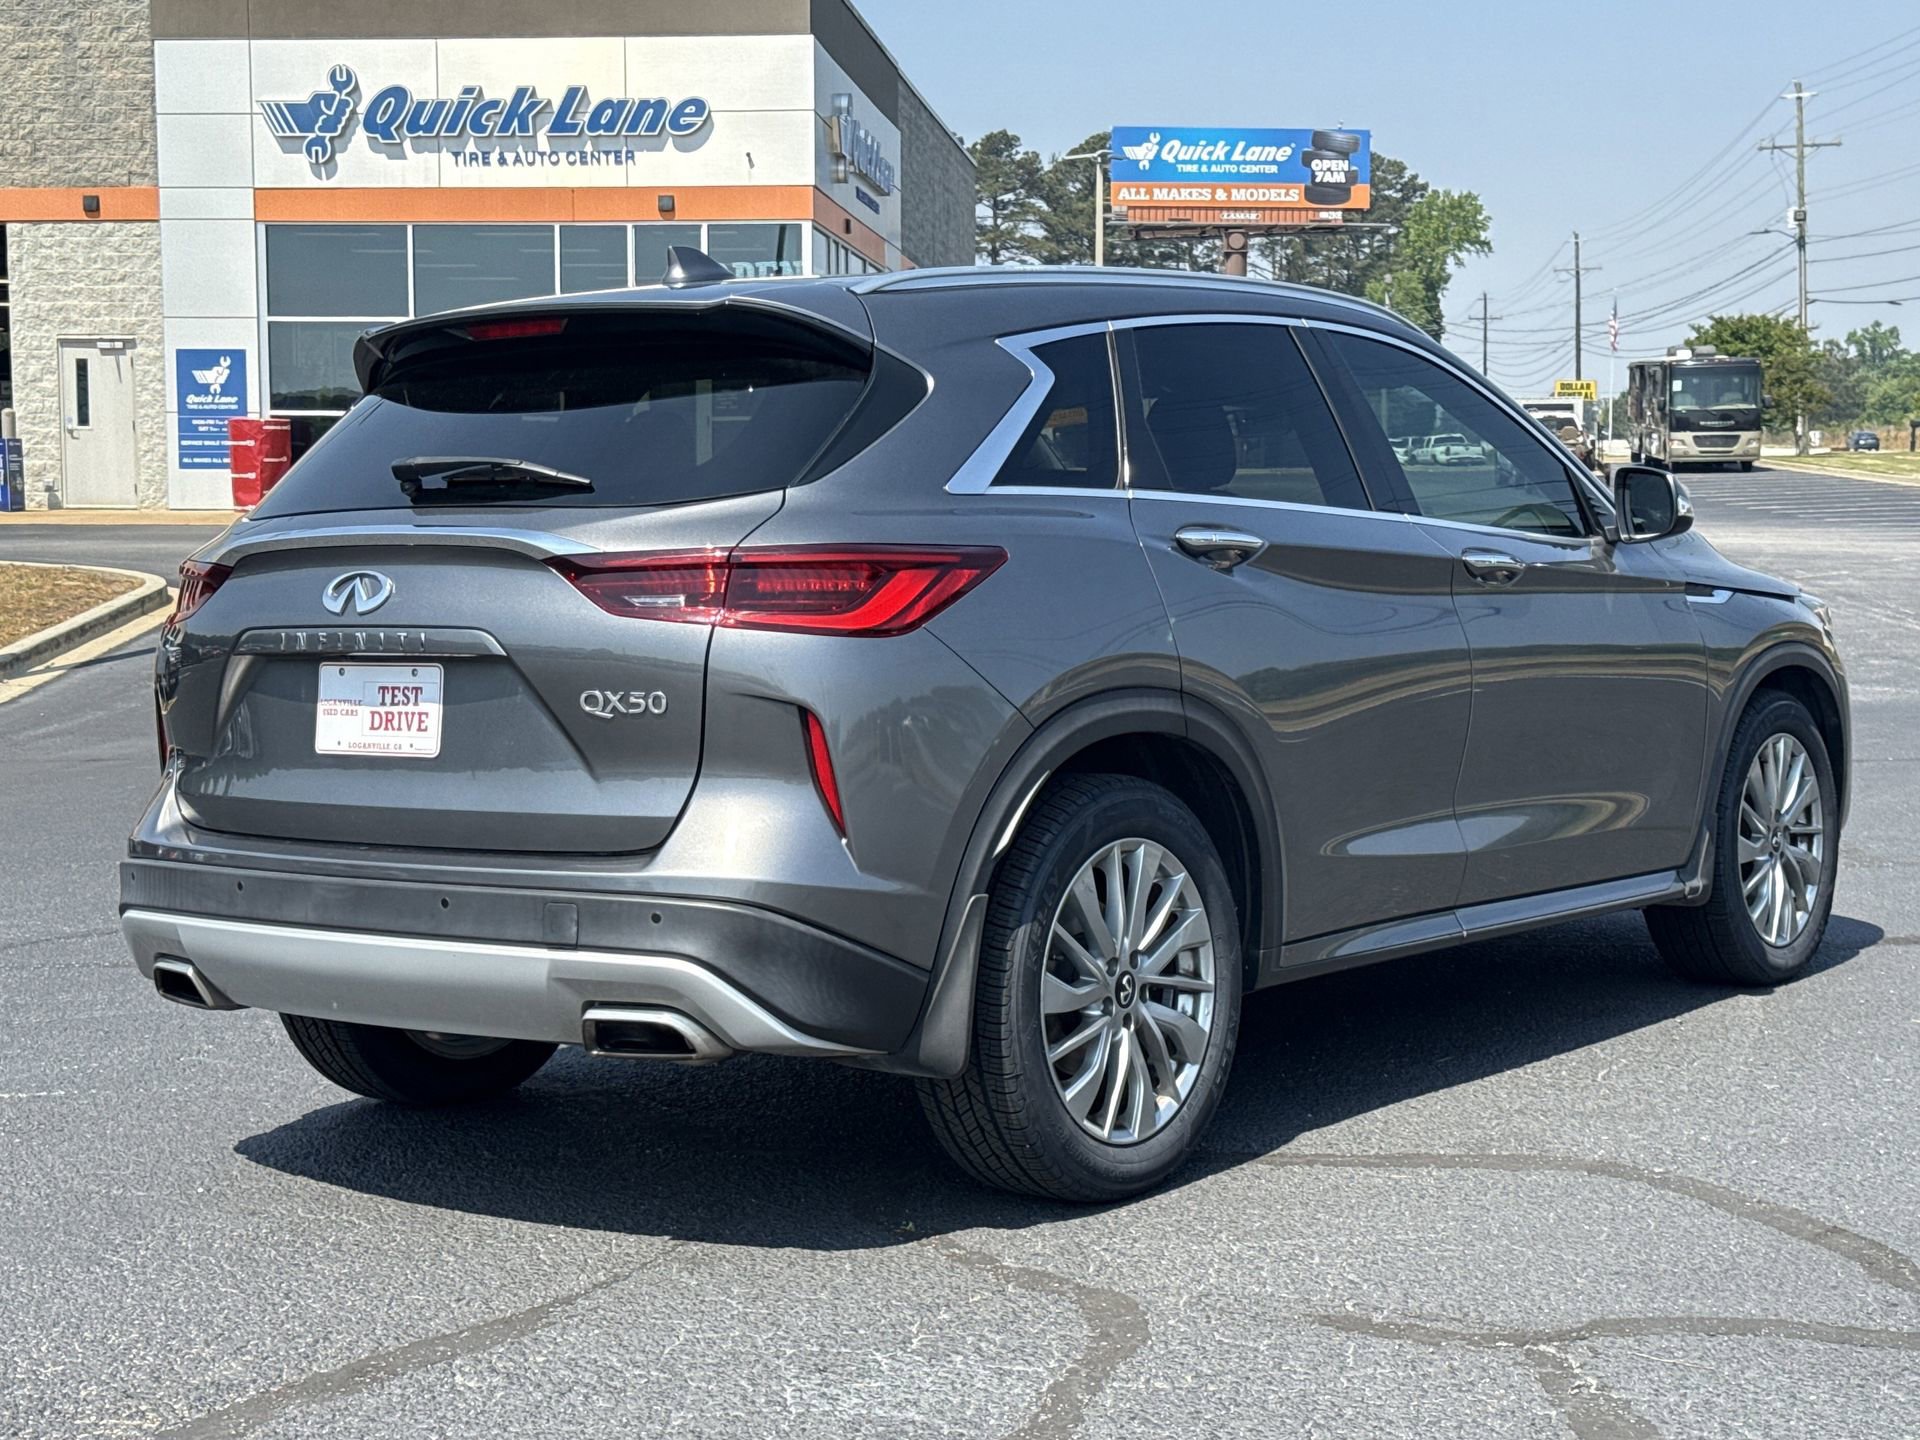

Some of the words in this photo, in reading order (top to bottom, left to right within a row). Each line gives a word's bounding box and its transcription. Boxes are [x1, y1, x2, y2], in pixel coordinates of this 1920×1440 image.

[362, 84, 542, 143] Quick
[546, 84, 710, 137] Lane
[452, 151, 491, 167] TIRE
[497, 151, 508, 167] &
[513, 151, 560, 167] AUTO
[566, 151, 636, 167] CENTER
[1160, 139, 1231, 163] Quick
[1231, 141, 1292, 162] Lane
[1176, 164, 1199, 173] TIRE
[1201, 164, 1208, 173] &
[1210, 164, 1238, 173] AUTO
[1239, 164, 1278, 174] CENTER
[1311, 159, 1349, 171] OPEN
[1315, 171, 1346, 183] 7AM
[1118, 187, 1149, 201] ALL
[1152, 188, 1212, 201] MAKES
[1215, 188, 1228, 201] &
[1231, 188, 1299, 202] MODELS
[1560, 382, 1591, 391] DOLLAR
[186, 394, 213, 404] Quick
[214, 395, 239, 403] Lane
[280, 632, 426, 651] INFINITI
[378, 685, 423, 707] TEST
[580, 690, 667, 719] QX50
[369, 711, 429, 732] DRIVE
